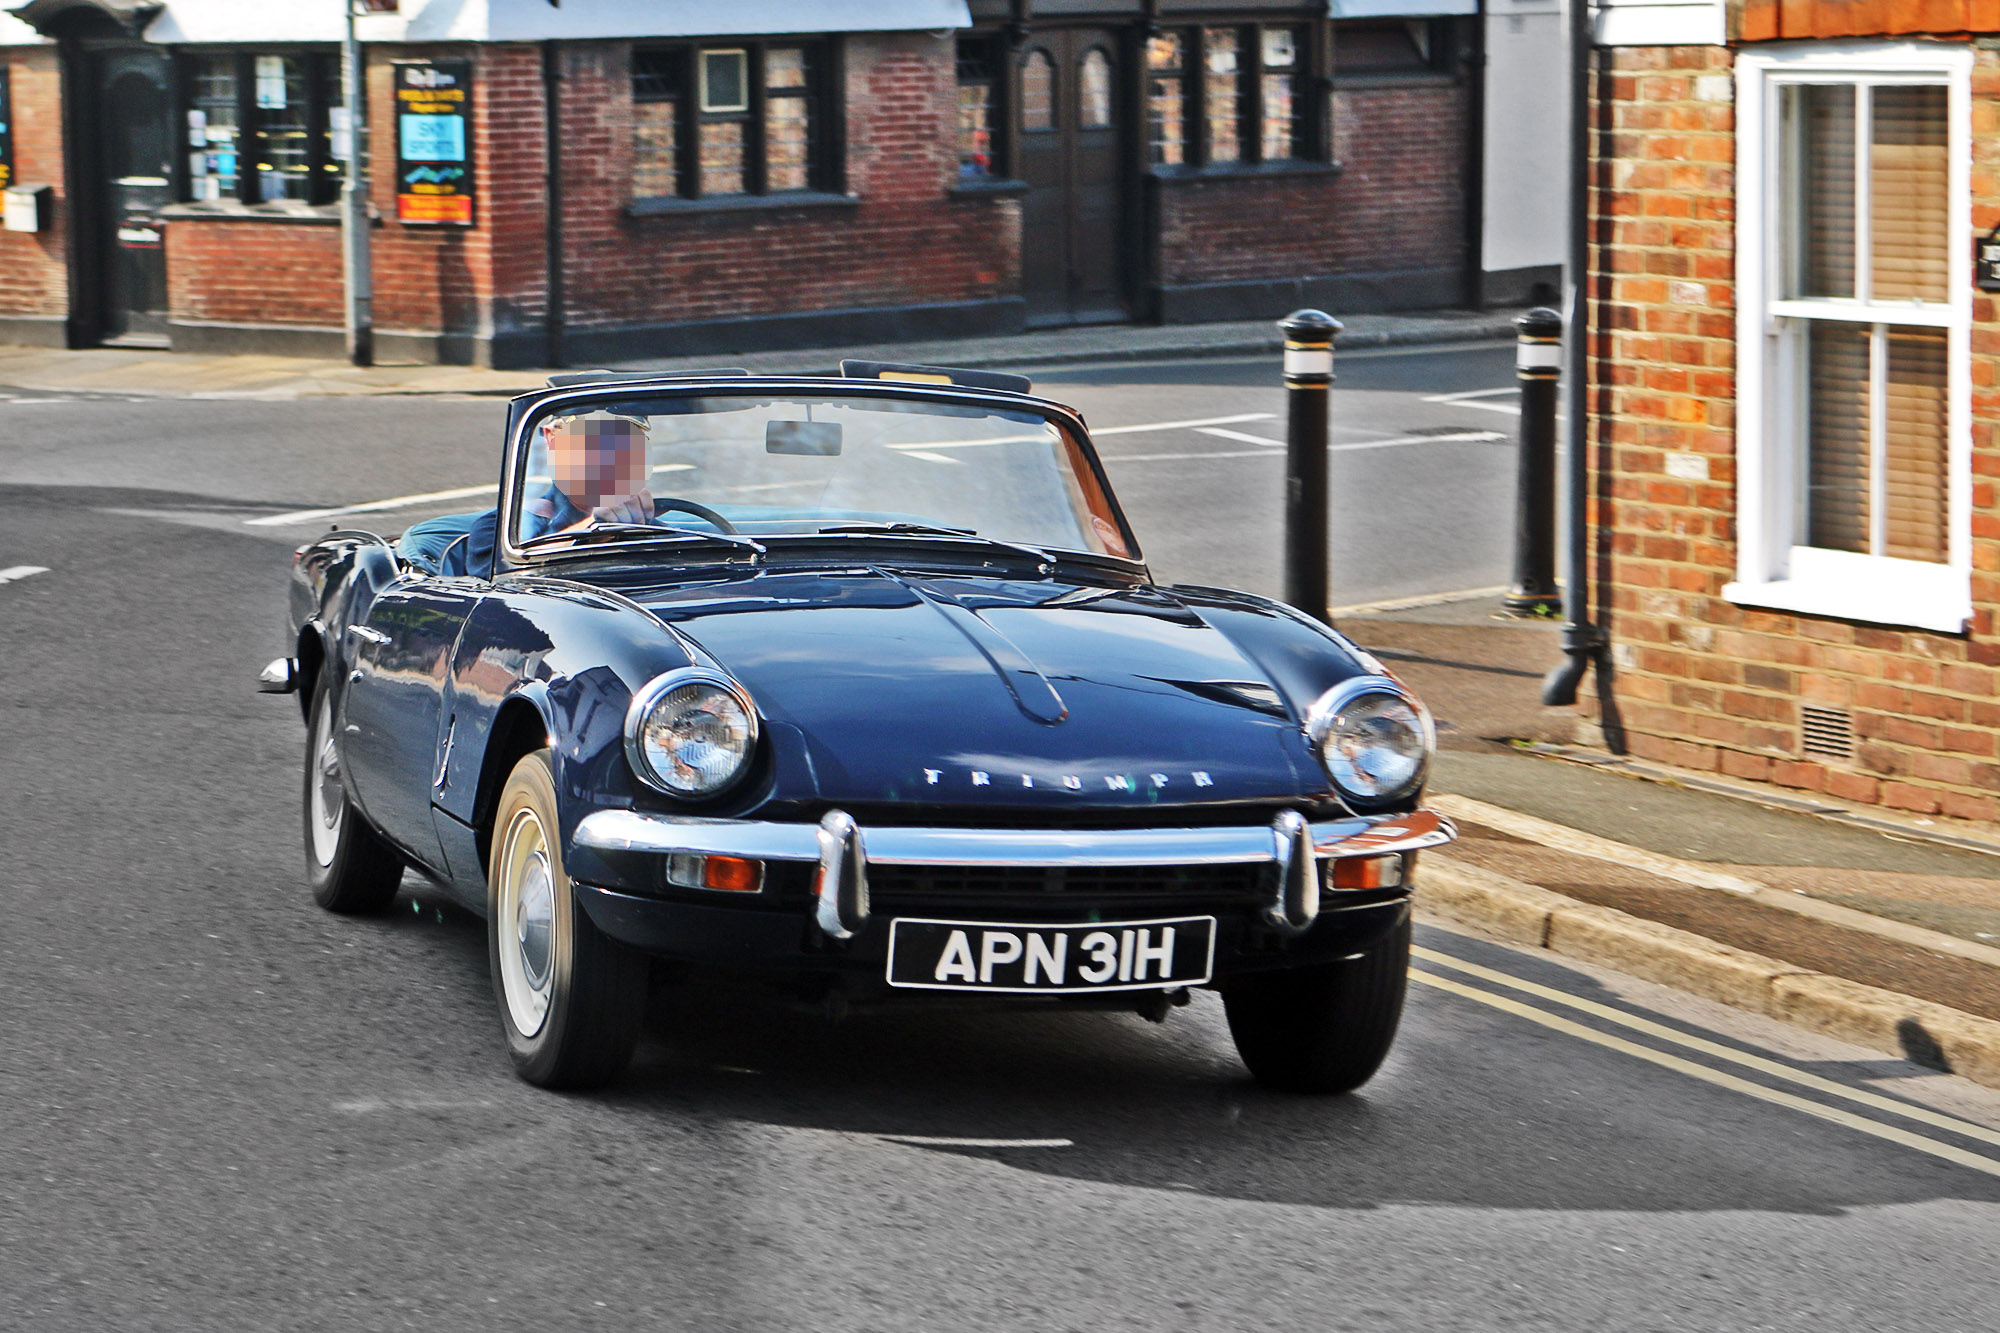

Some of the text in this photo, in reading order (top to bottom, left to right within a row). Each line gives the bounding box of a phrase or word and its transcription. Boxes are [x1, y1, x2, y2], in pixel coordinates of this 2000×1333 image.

[923, 767, 1214, 790] TRIUMPH
[935, 927, 1175, 984] APN 31H
